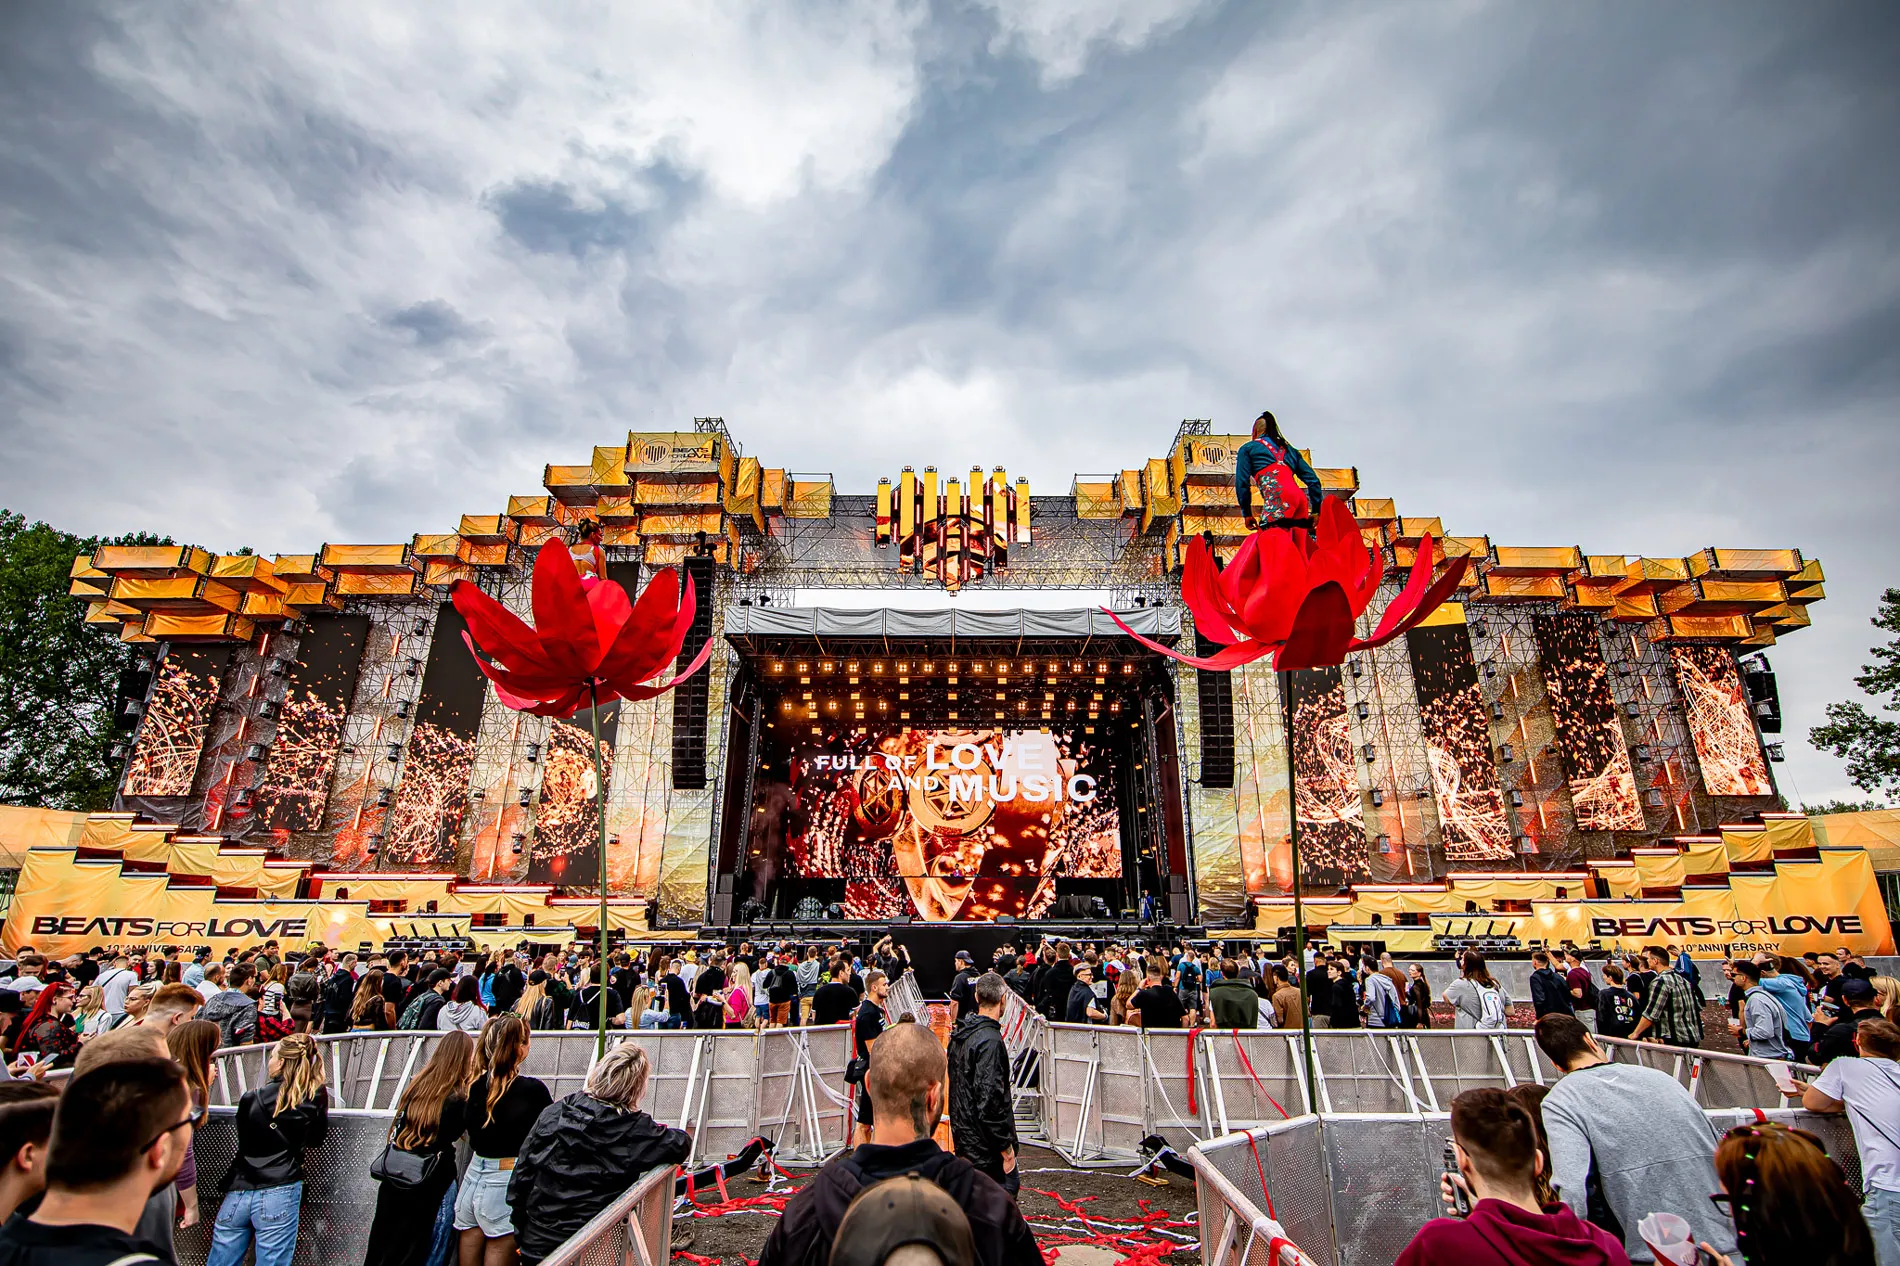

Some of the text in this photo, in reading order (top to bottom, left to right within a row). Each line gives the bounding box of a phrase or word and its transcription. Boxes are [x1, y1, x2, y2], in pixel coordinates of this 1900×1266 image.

[816, 743, 1044, 770] FULL OF LOVE
[887, 774, 1097, 802] AND MUSIC
[31, 916, 308, 938] BEATS FOR LOVE
[1592, 915, 1863, 936] BEATS FOR LOVE
[1698, 943, 1780, 952] ANNIERSARY
